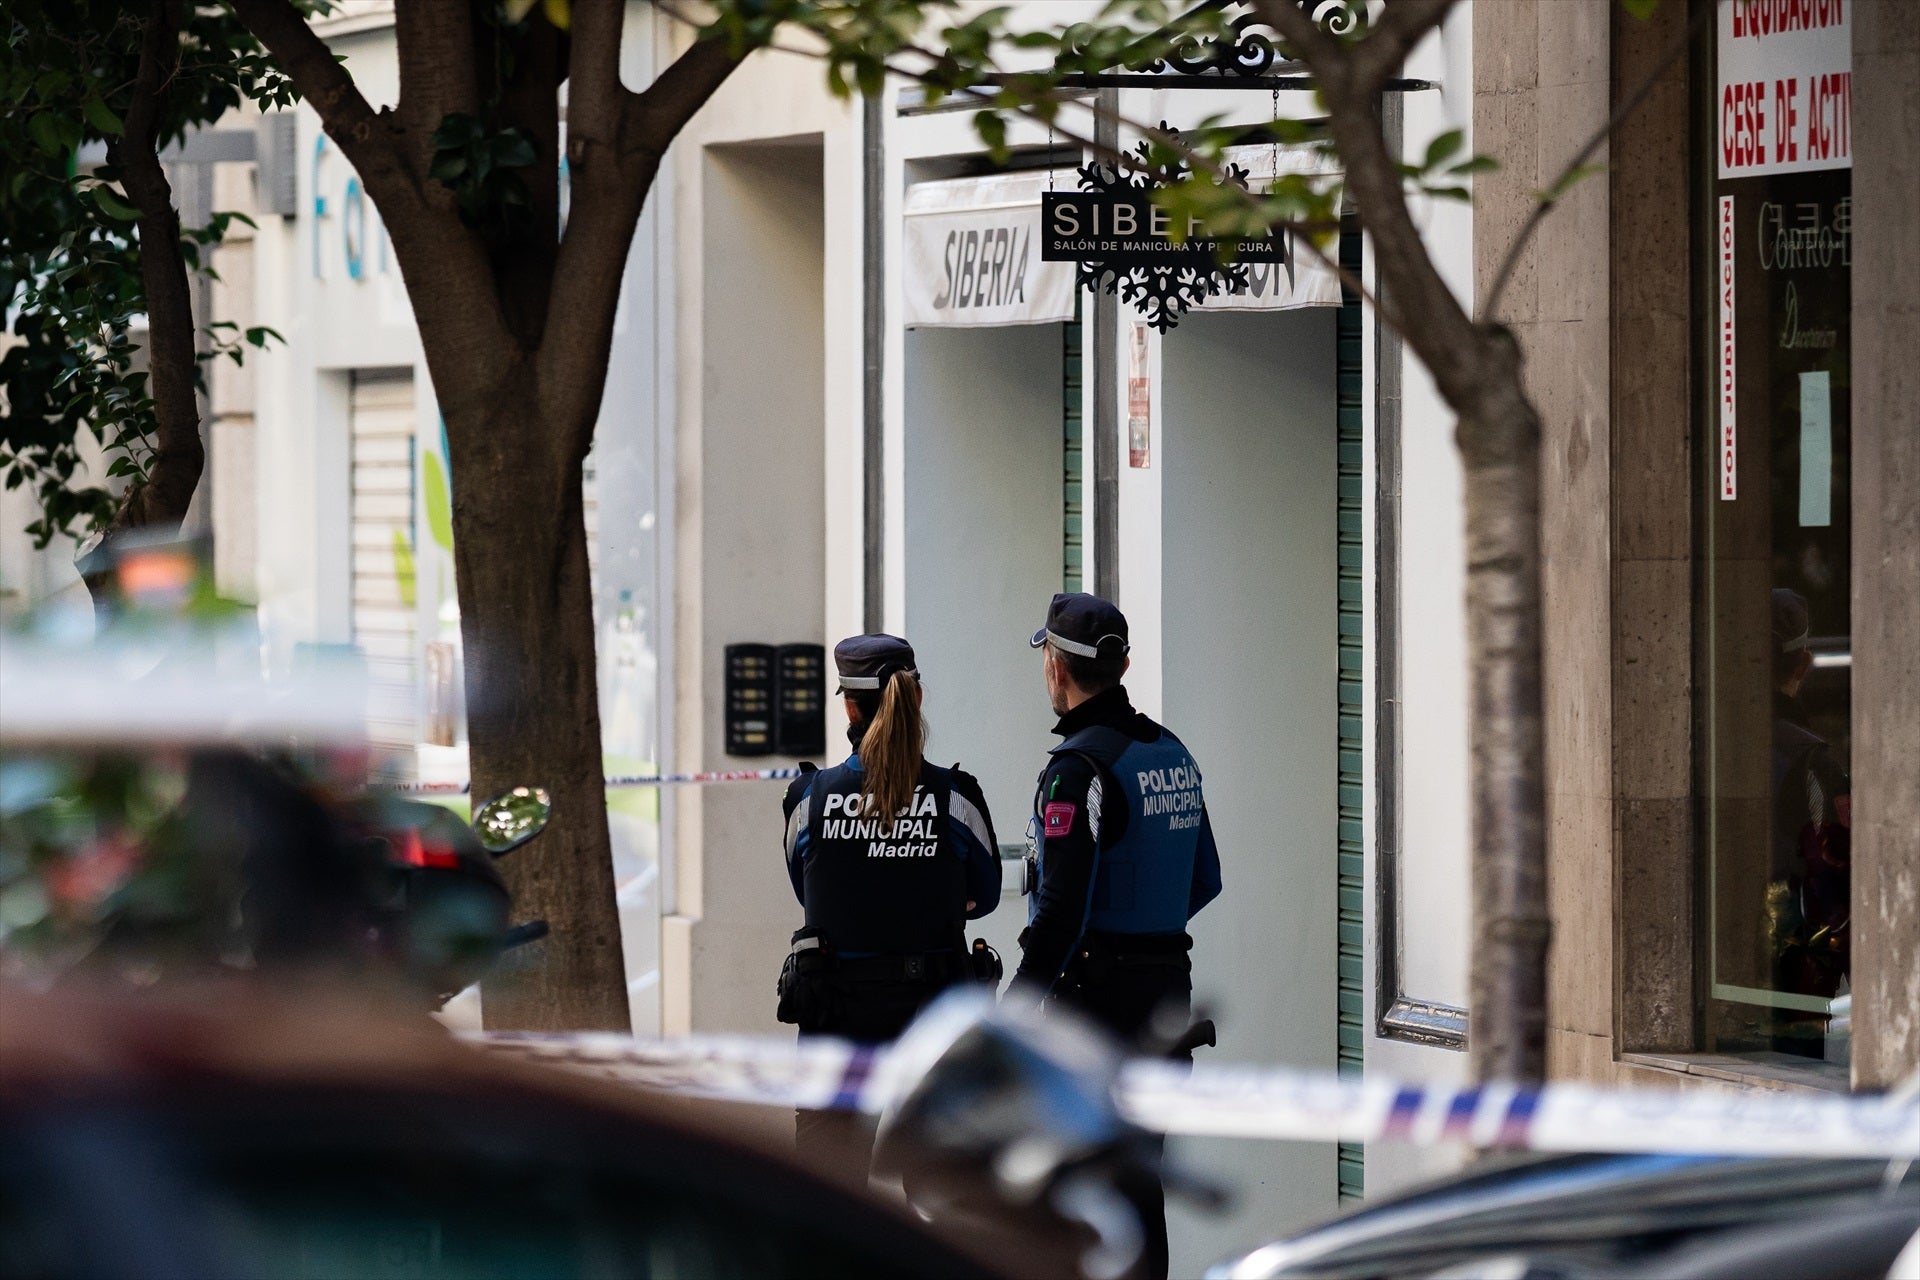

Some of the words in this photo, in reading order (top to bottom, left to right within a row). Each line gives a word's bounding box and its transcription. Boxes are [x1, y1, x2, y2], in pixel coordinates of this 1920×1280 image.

[1723, 81, 1765, 168] CESE
[1776, 78, 1797, 163] DE
[1053, 203, 1274, 237] SIBE
[1053, 238, 1096, 251] SALÓN
[1101, 241, 1118, 251] DE
[1123, 241, 1189, 252] MANICURA
[1195, 242, 1203, 252] Y
[1208, 242, 1273, 253] PEICURA
[933, 224, 1030, 310] SIBERIA
[1723, 200, 1732, 414] JUBILACIÓN
[1136, 757, 1200, 795] POLICÍA
[822, 784, 938, 817] POLÍA
[1143, 789, 1203, 817] MUNICIPAL
[822, 819, 938, 839] MUNICIPAL
[1169, 811, 1201, 830] Madrid
[867, 841, 938, 857] Madrid
